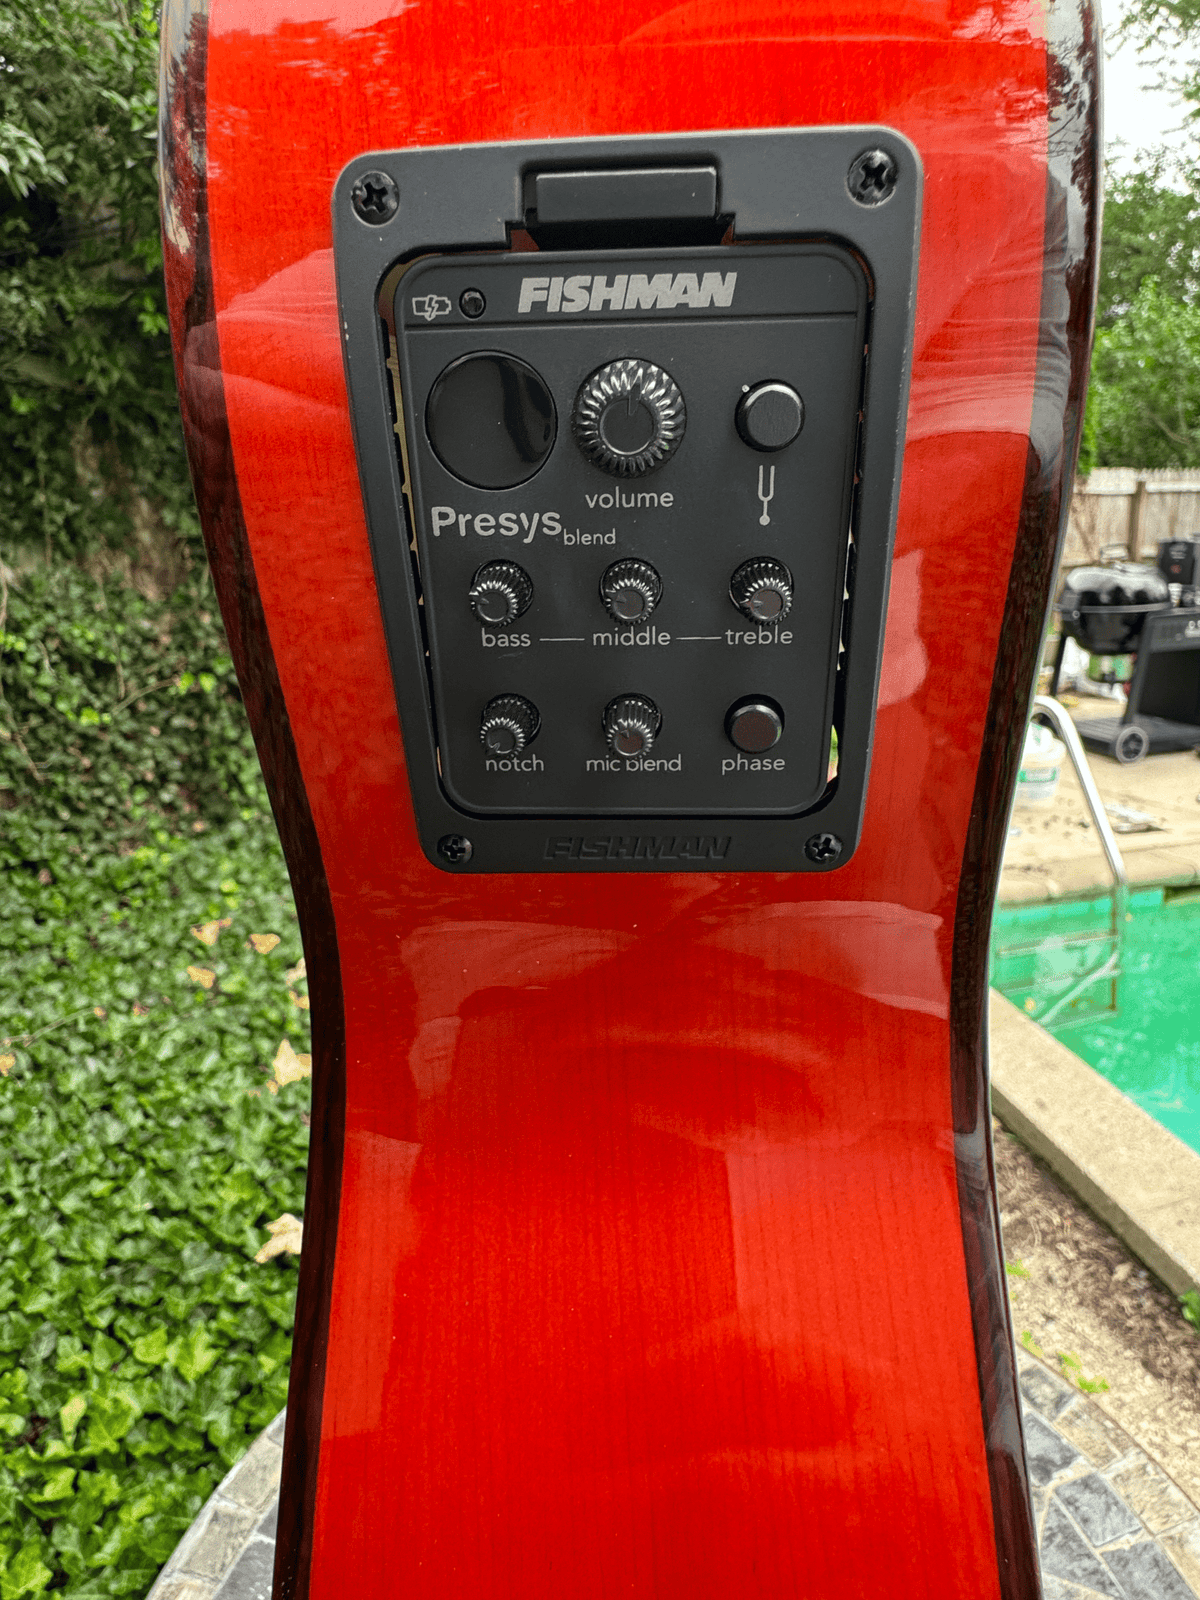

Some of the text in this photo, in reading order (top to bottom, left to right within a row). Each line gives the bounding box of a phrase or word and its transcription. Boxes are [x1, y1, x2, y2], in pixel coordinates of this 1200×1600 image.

[517, 271, 737, 313] FISHMAN
[585, 487, 674, 508] volume
[430, 506, 616, 546] Presys blend
[481, 627, 793, 647] bass middle treble
[485, 755, 544, 772] notch
[586, 756, 622, 772] mic
[721, 755, 785, 775] phase
[543, 836, 732, 860] FISHMAN
